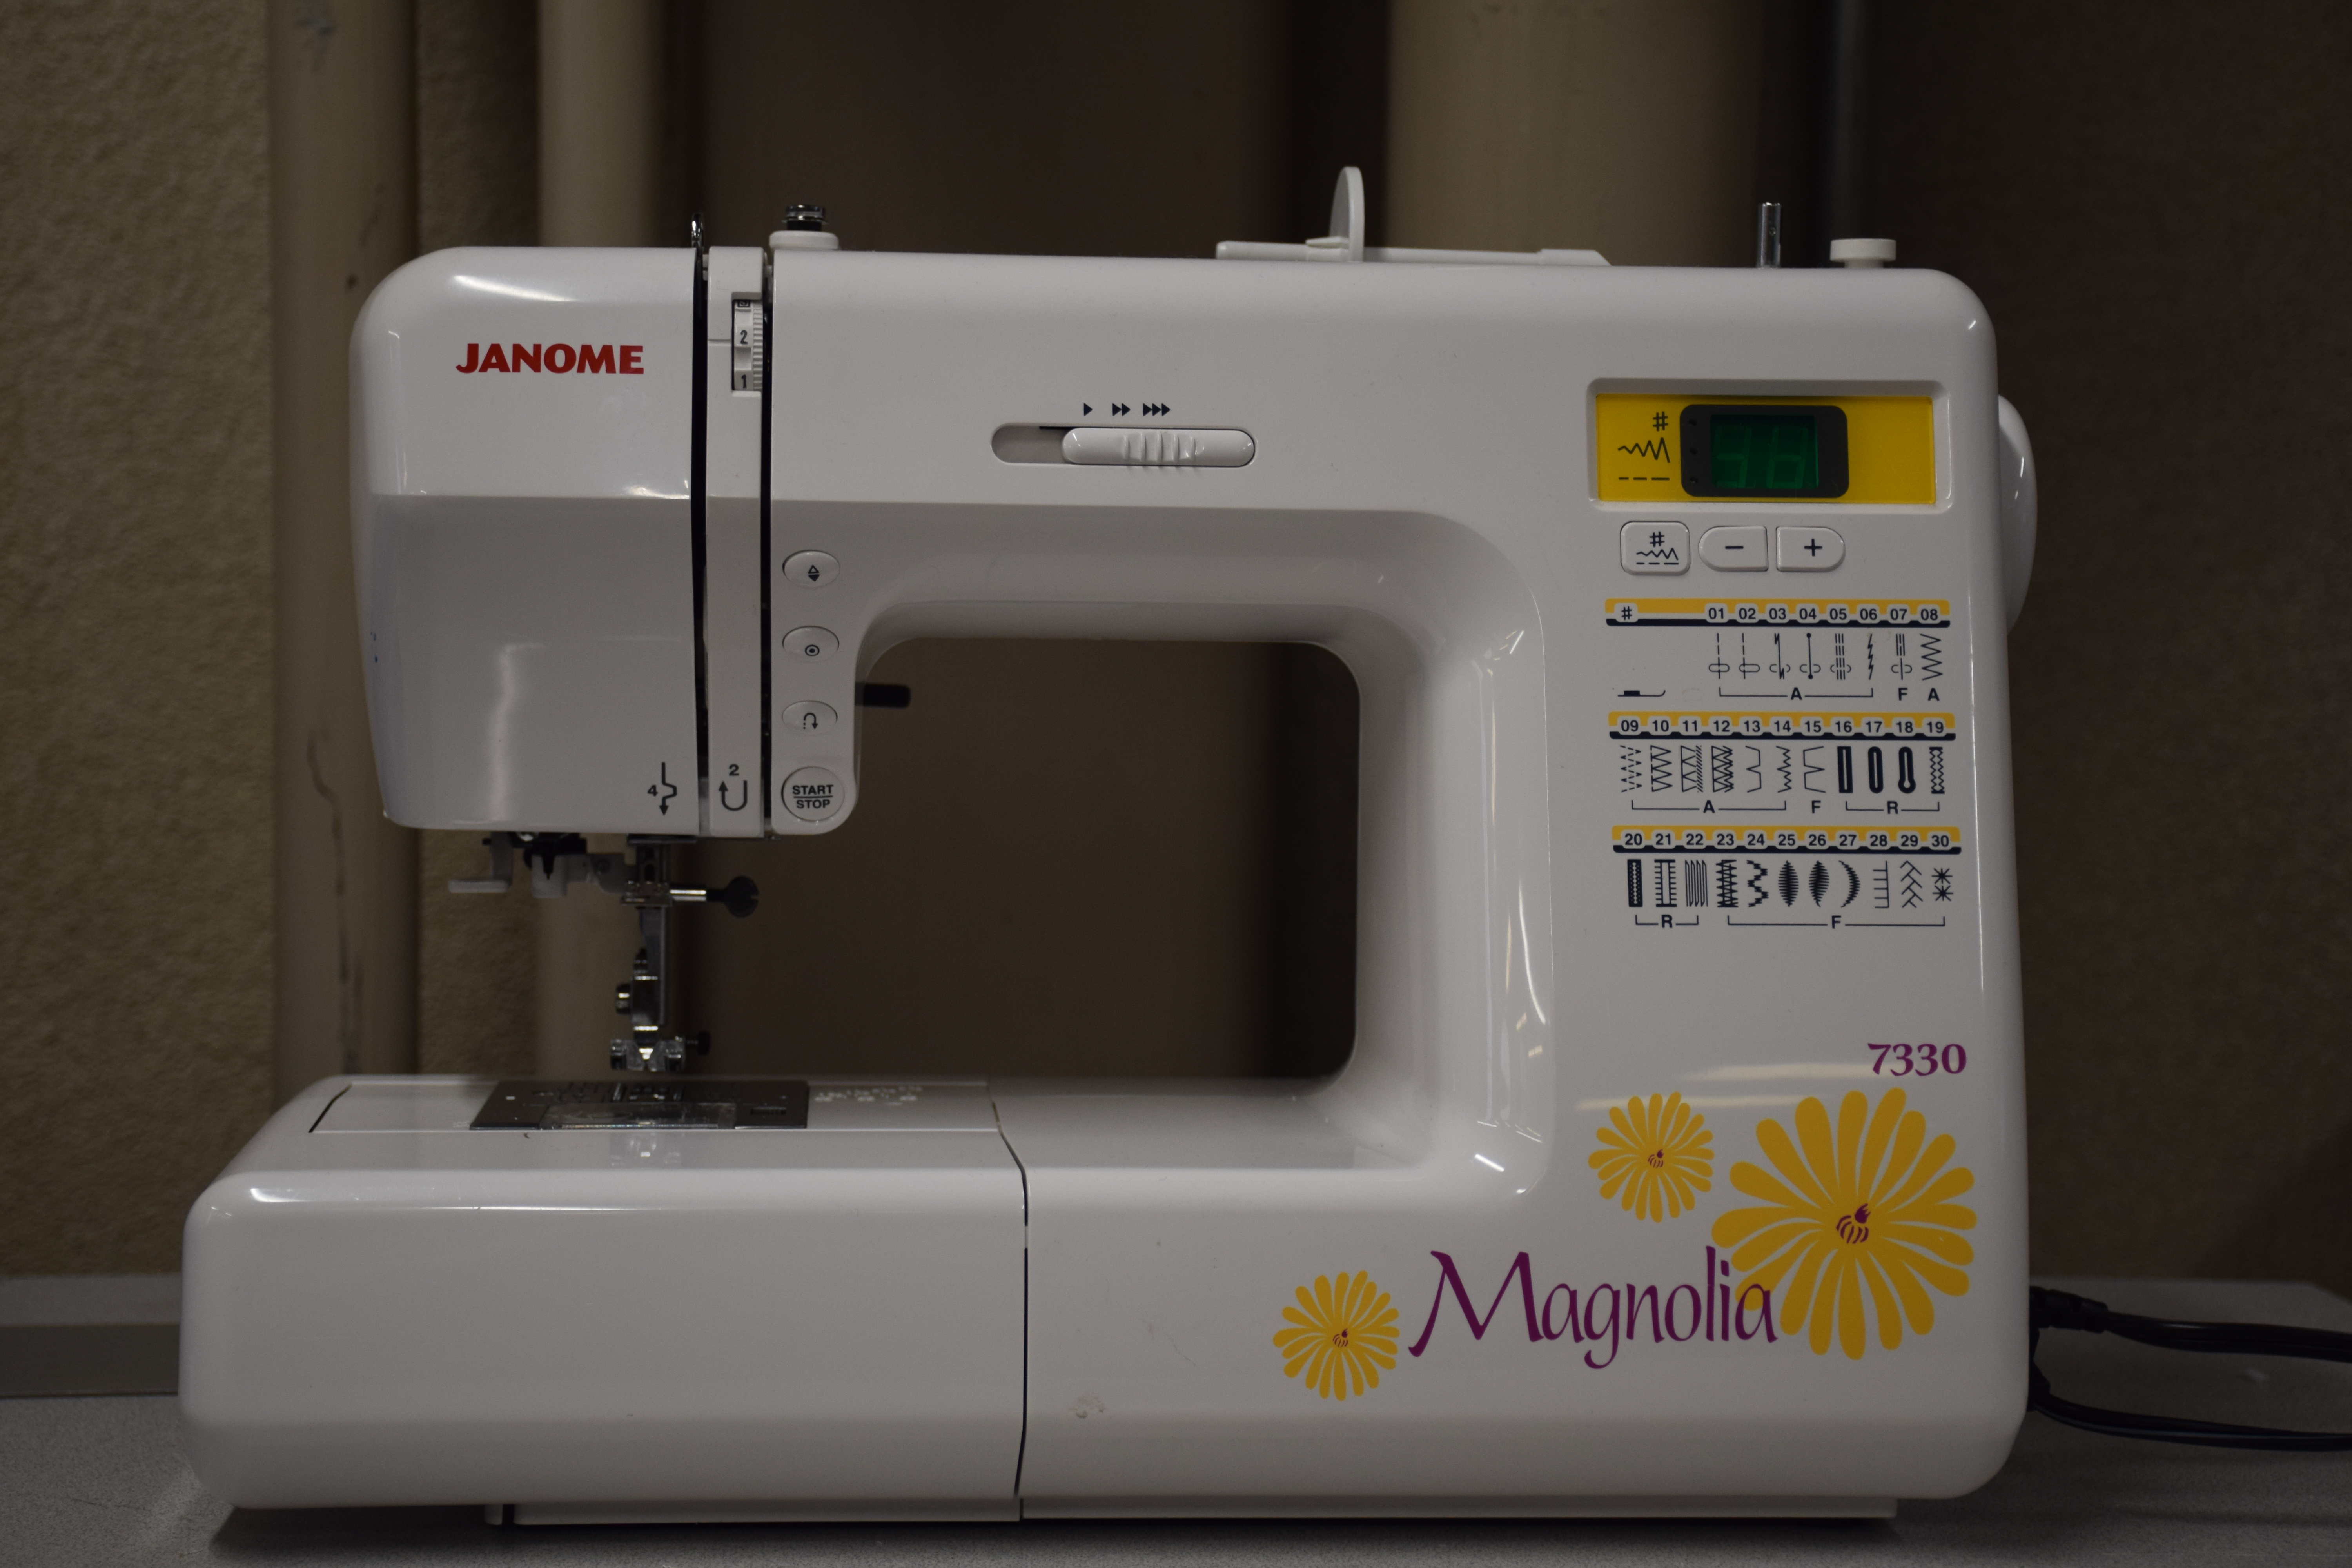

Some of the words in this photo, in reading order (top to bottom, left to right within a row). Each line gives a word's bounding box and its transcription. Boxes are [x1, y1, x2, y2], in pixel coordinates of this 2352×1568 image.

[740, 330, 748, 345] 2
[456, 343, 644, 374] JANOME
[741, 374, 747, 389] 1
[1709, 608, 1724, 620] 01
[1739, 608, 1756, 620] 02
[1769, 608, 1786, 620] 03
[1799, 608, 1817, 620] 04
[1829, 608, 1847, 620] 05
[1860, 608, 1877, 621] 06
[1890, 608, 1907, 621] 07
[1920, 608, 1938, 621] 08
[1791, 687, 1802, 700] A
[1898, 687, 1908, 701] F
[1927, 688, 1940, 701] A
[1621, 720, 1639, 733] 09
[1652, 720, 1669, 732] 10
[1682, 720, 1697, 732] 11
[1713, 720, 1730, 733] 12
[1744, 720, 1760, 733] 13
[1774, 720, 1791, 733] 14
[1805, 720, 1822, 733] 15
[1835, 720, 1852, 733] 16
[1866, 721, 1883, 734] 17
[1896, 721, 1913, 734] 18
[1927, 721, 1944, 734] 19
[729, 764, 739, 776] 2
[648, 785, 658, 797] 4
[792, 784, 834, 795] START
[796, 799, 830, 809] STOP
[1703, 800, 1715, 813] A
[1811, 800, 1821, 814] F
[1887, 800, 1898, 814] R
[1625, 833, 1642, 846] 20
[1655, 833, 1671, 846] 21
[1686, 833, 1704, 846] 22
[1717, 833, 1734, 846] 23
[1748, 833, 1765, 846] 24
[1778, 834, 1796, 846] 25
[1809, 834, 1826, 846] 26
[1839, 834, 1857, 846] 27
[1870, 834, 1888, 847] 28
[1901, 835, 1918, 847] 29
[1931, 835, 1949, 847] 30
[1661, 914, 1673, 928] R
[1831, 915, 1842, 929] F
[1867, 1043, 1967, 1076] 7330
[1408, 1246, 1778, 1369] Magnolia
